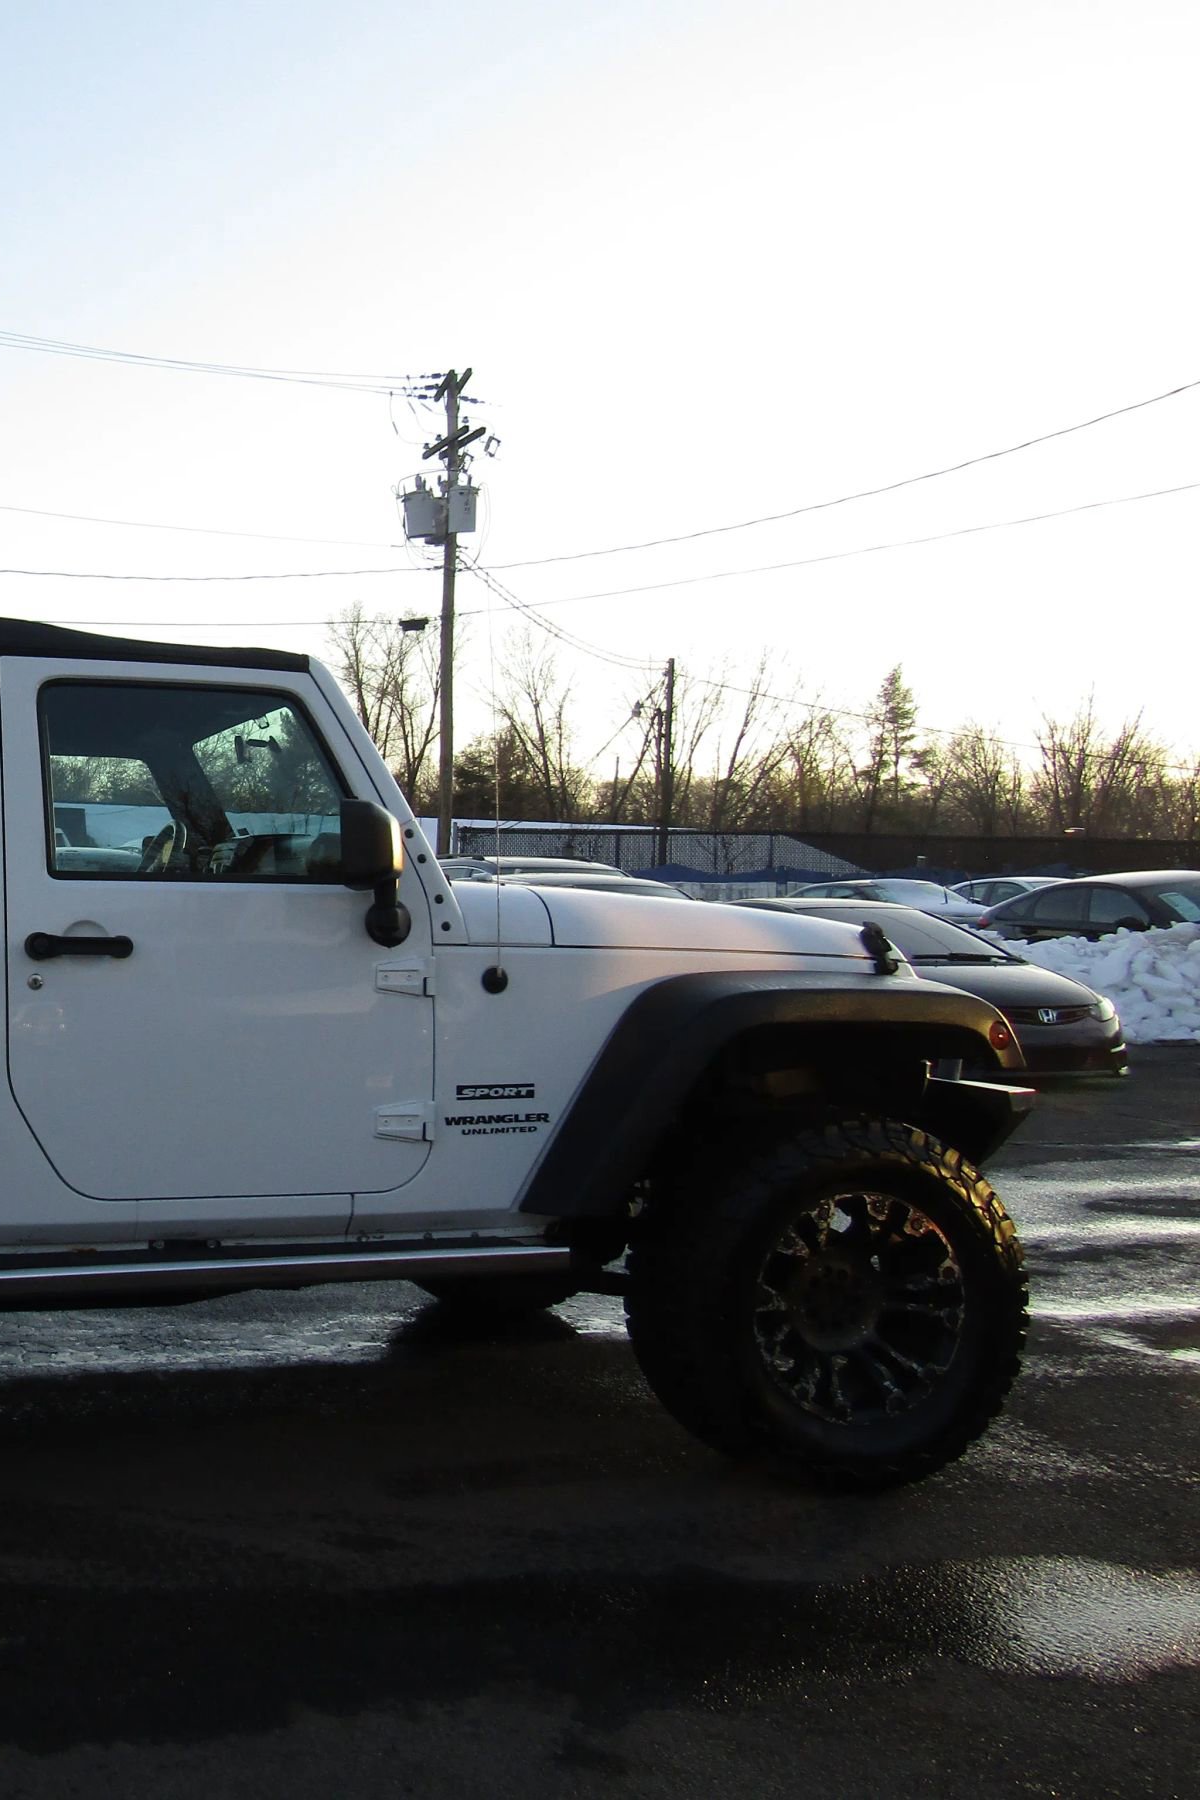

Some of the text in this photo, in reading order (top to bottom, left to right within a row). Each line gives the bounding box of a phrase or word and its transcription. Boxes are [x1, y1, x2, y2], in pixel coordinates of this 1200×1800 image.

[456, 1087, 535, 1098] SPORT
[444, 1113, 550, 1126] WRANGLER
[461, 1126, 538, 1136] UNLIMITED
